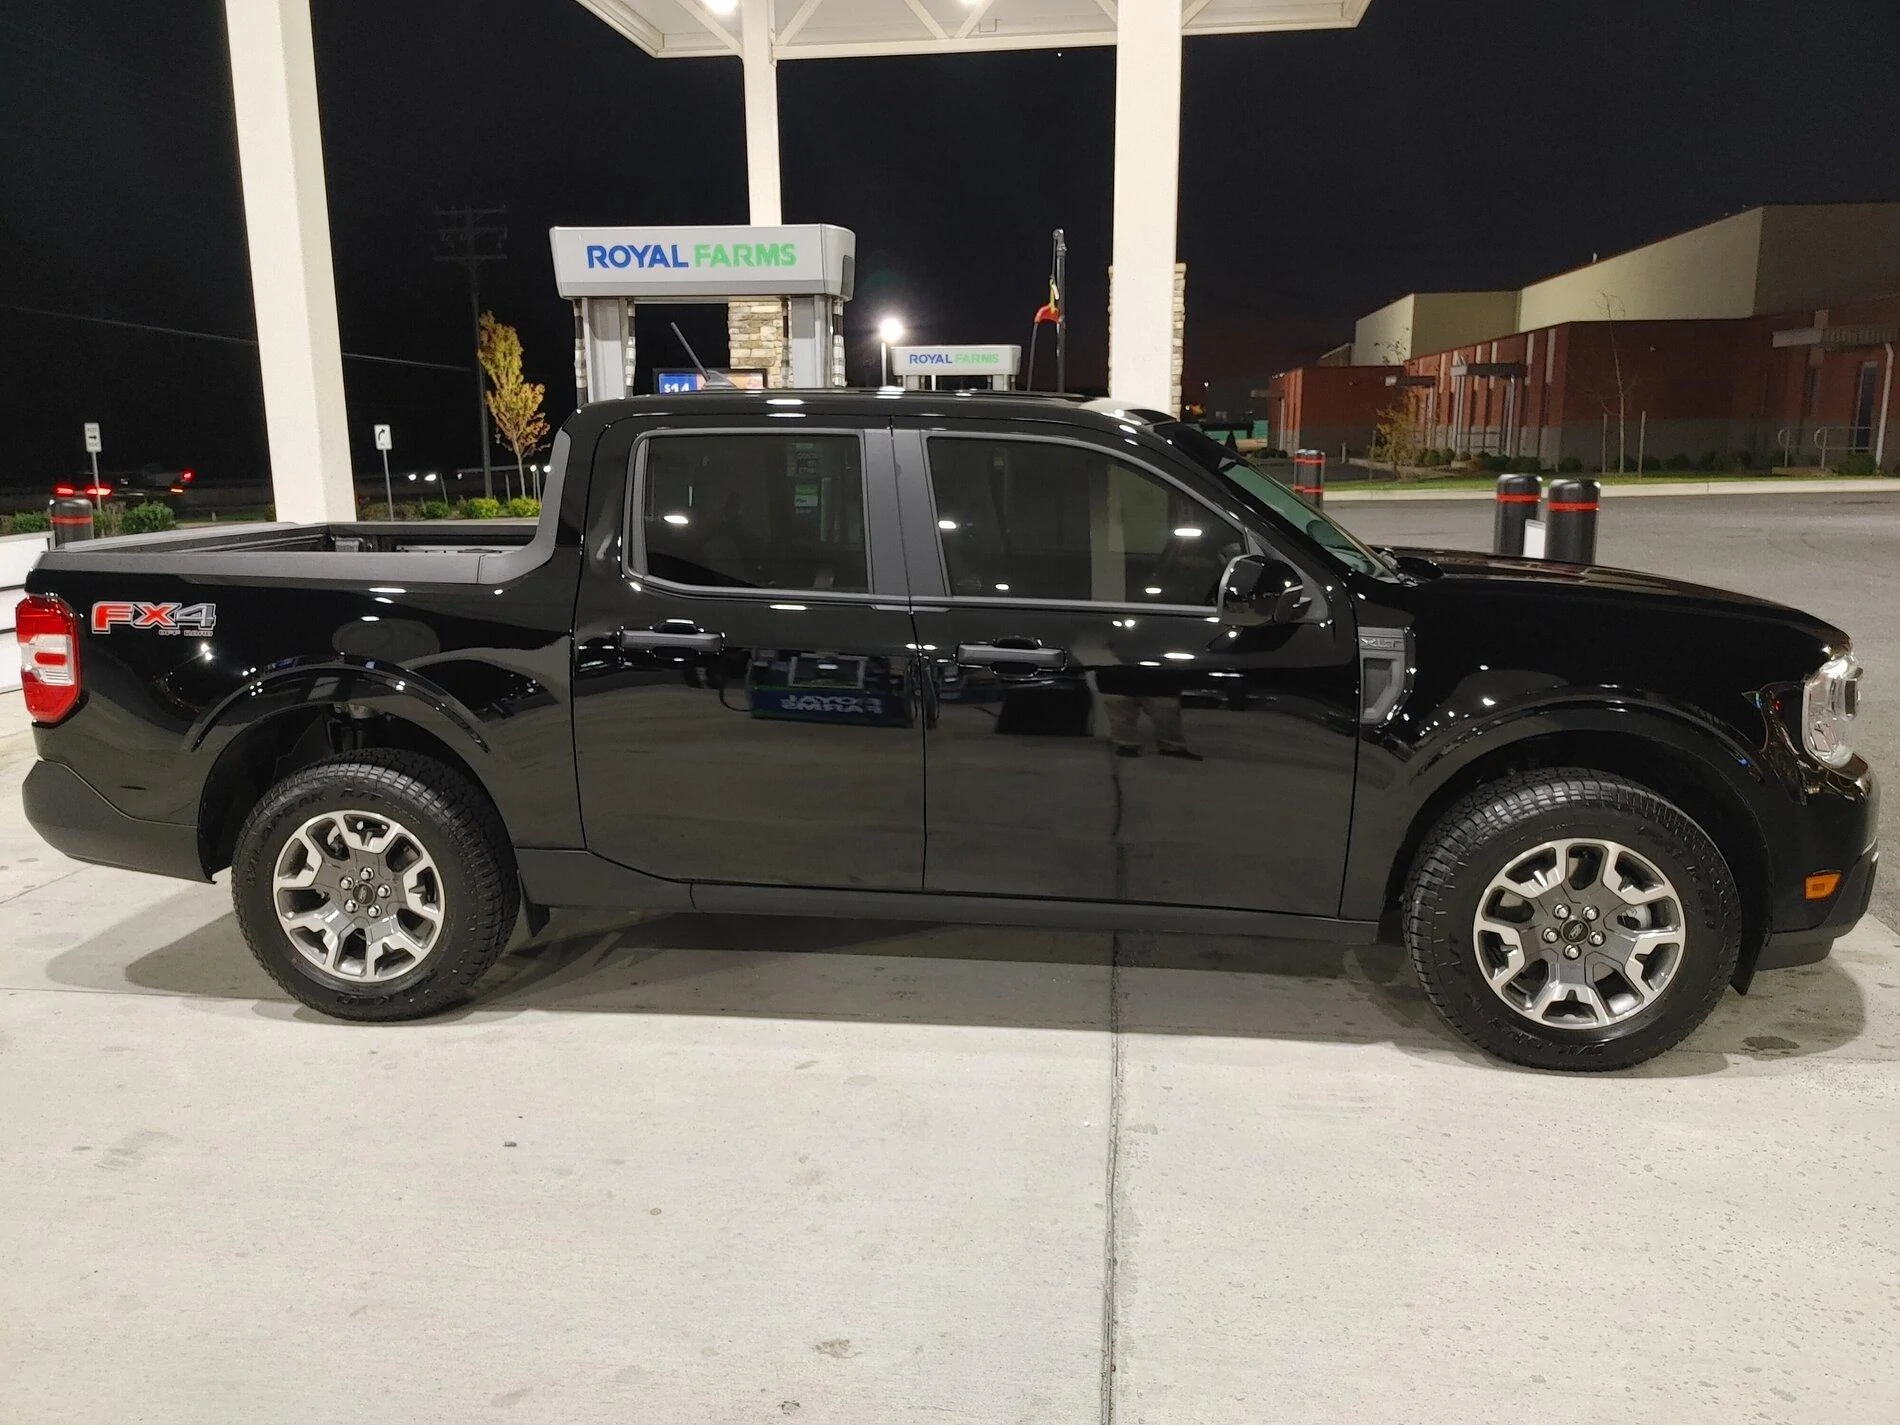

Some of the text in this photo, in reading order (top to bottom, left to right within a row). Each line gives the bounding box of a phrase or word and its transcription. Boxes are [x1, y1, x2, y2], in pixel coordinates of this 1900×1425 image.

[586, 243, 797, 269] ROYAL FARMS
[909, 353, 1001, 365] ROYAL FARMS
[92, 602, 216, 634] FX4
